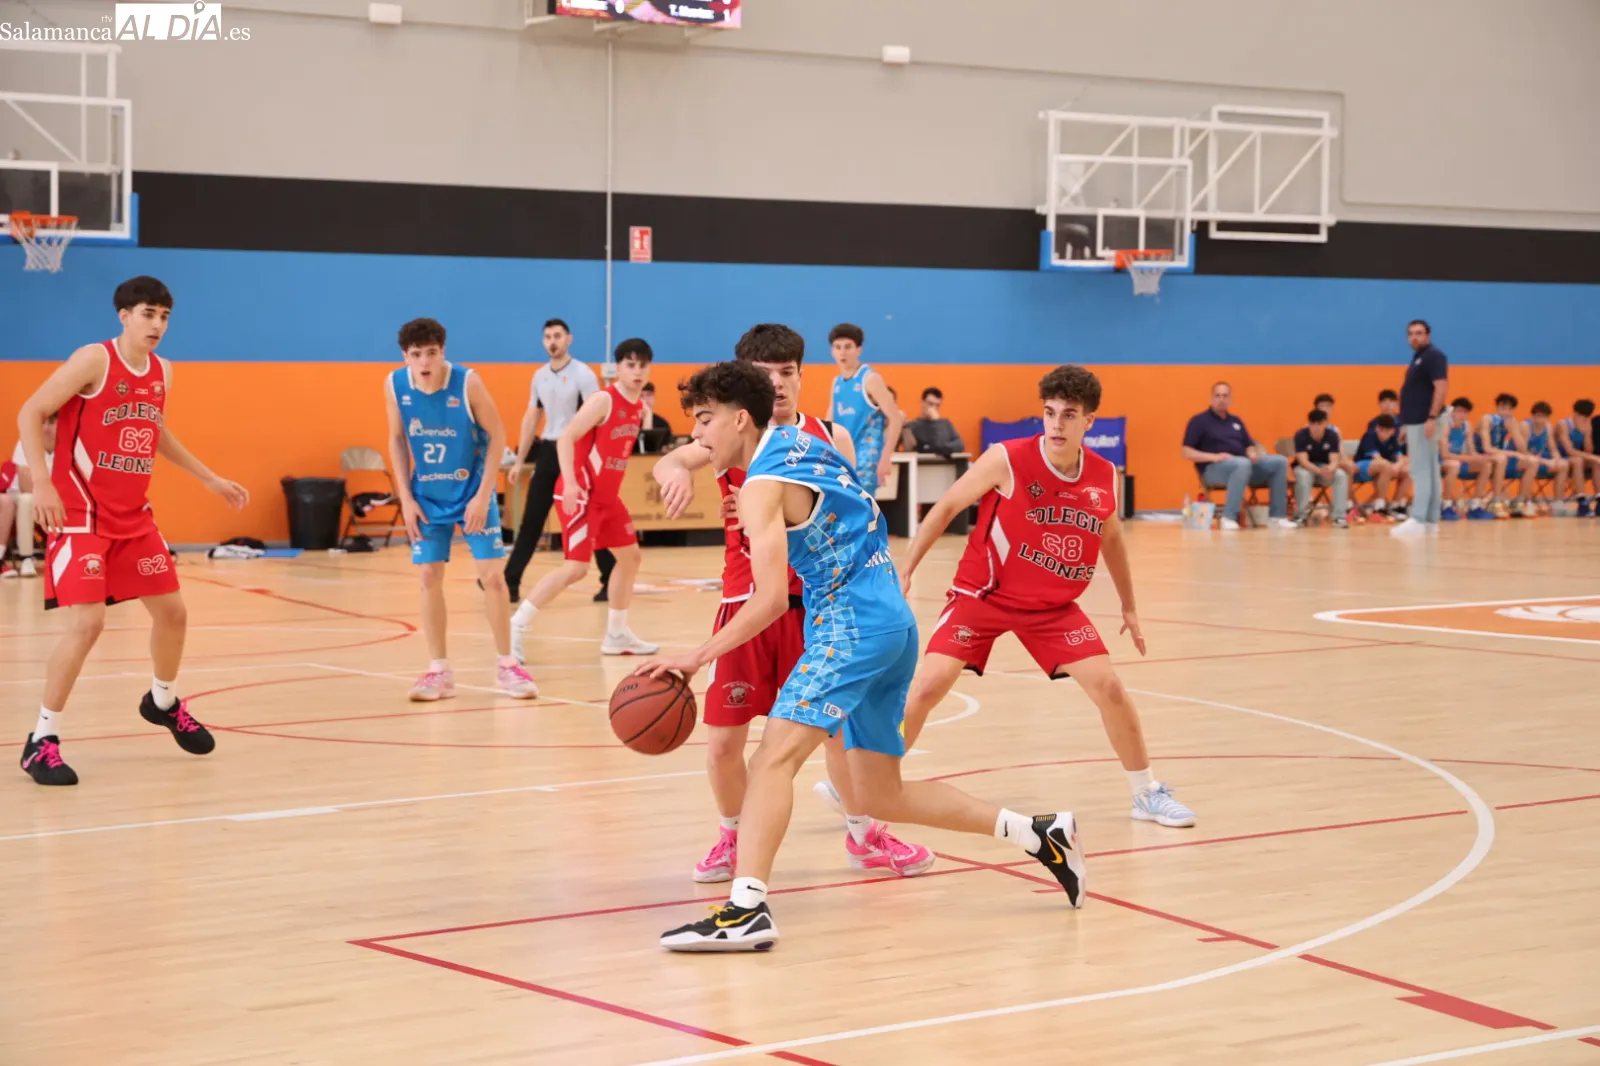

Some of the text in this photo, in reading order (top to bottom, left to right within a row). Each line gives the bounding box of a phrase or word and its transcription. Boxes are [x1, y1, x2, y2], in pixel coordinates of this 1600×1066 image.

[118, 426, 154, 453] 62
[423, 442, 447, 464] 27
[1042, 532, 1083, 562] 68
[137, 554, 169, 576] 62
[1064, 624, 1098, 646] 68
